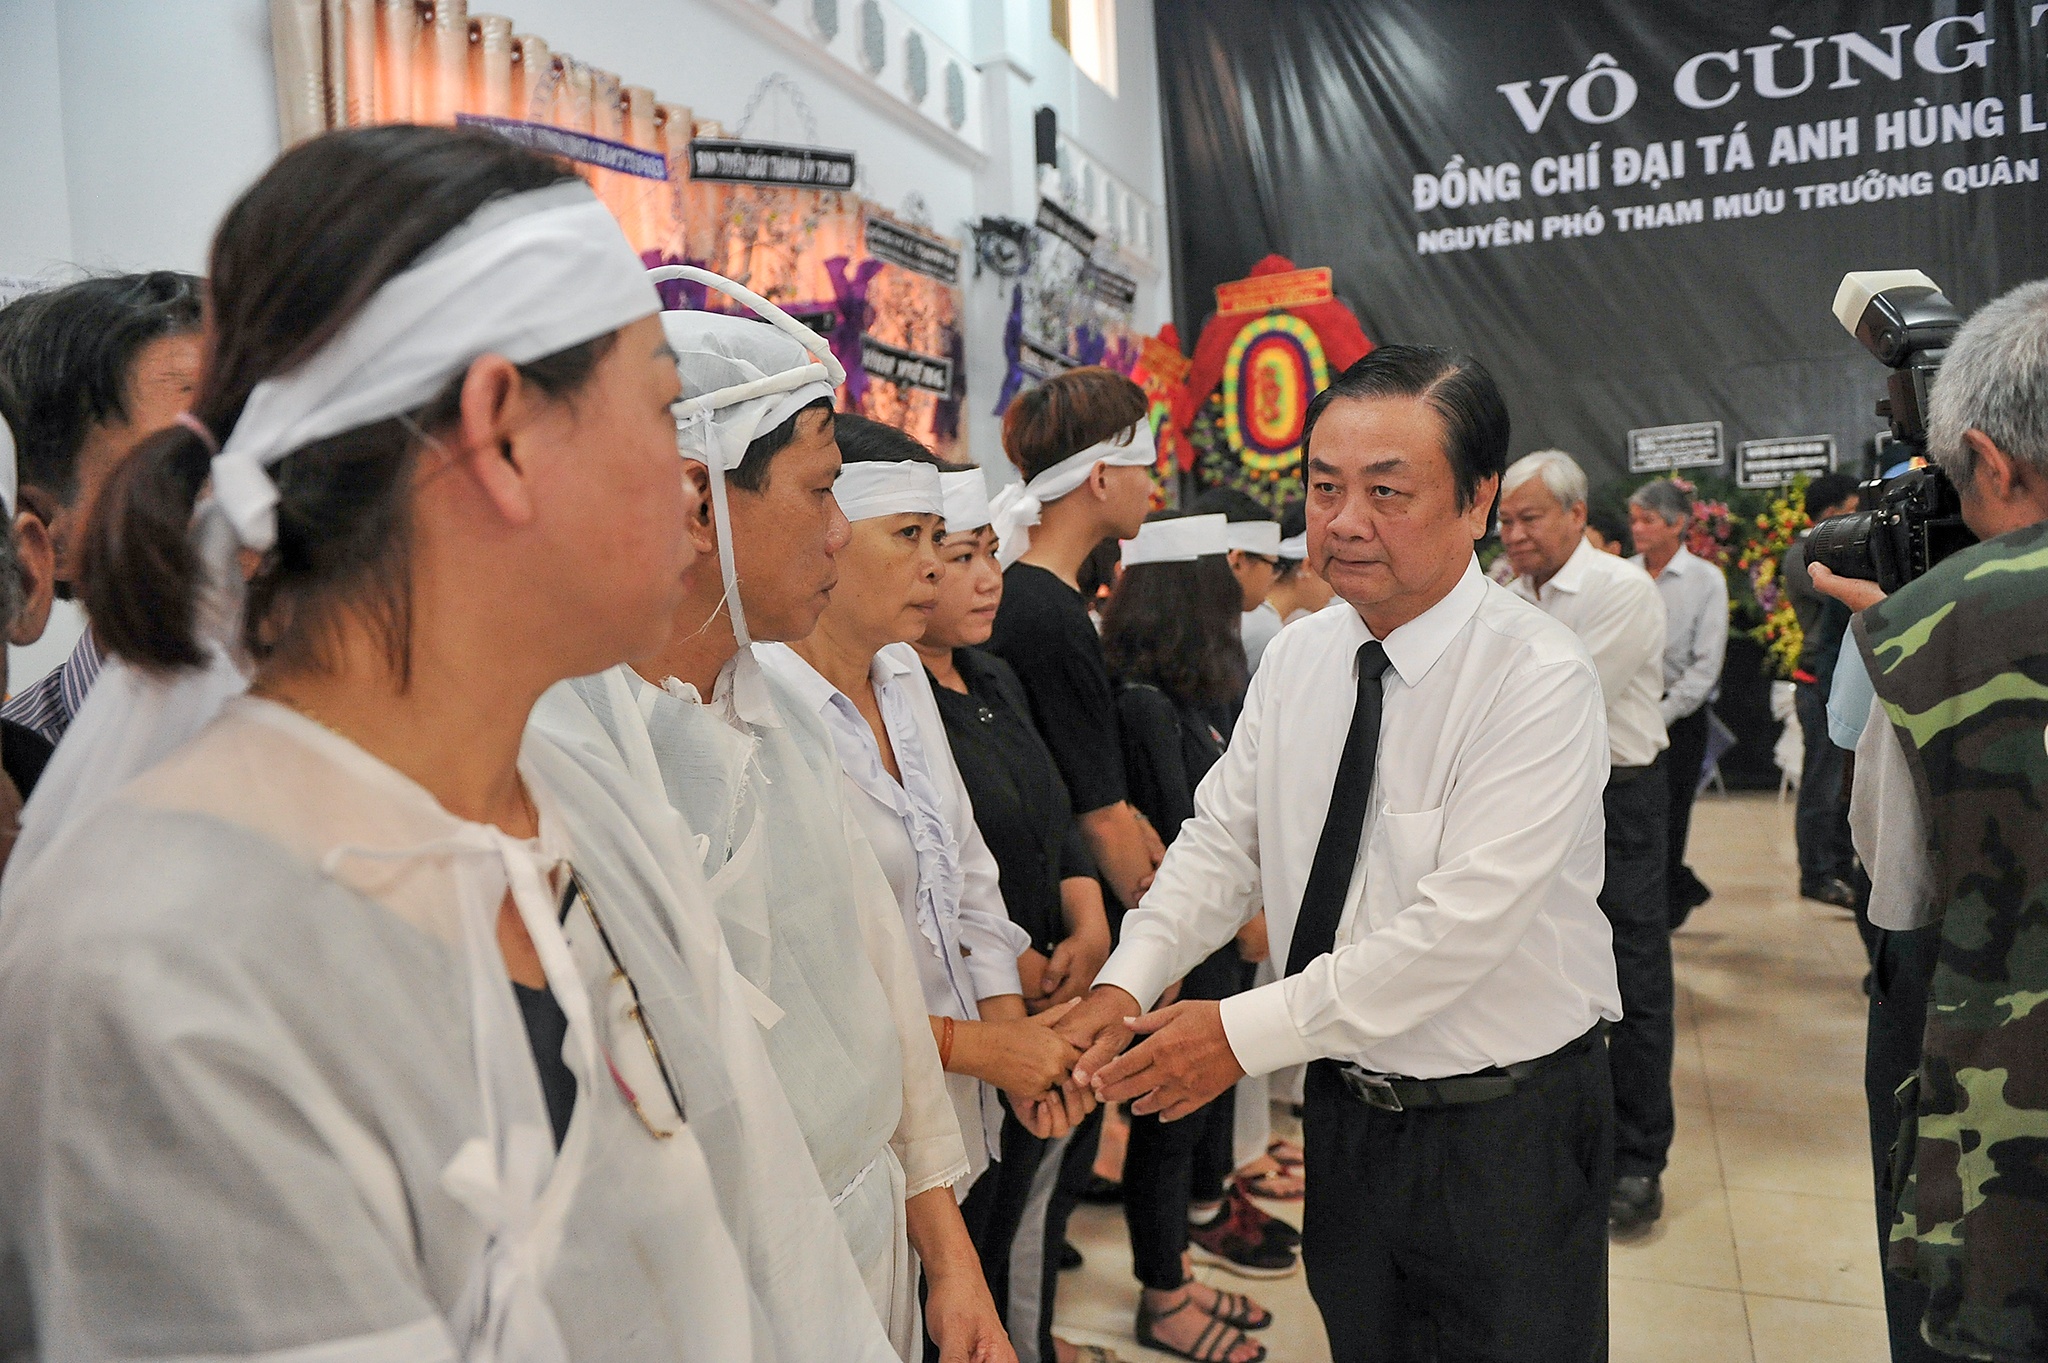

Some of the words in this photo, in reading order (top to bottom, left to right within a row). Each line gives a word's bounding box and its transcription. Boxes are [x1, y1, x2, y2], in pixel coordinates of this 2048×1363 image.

[1496, 52, 1638, 133] VÔ
[1673, 11, 1995, 109] CÙNG
[1412, 153, 1522, 212] ĐỒNG
[1530, 141, 1602, 196] CHÍ
[1612, 140, 1685, 190] ĐẠI
[1695, 121, 1755, 175] TÁ
[1768, 116, 1859, 167] ANH
[1875, 97, 2004, 152] HÙNG
[1417, 216, 1535, 255] NGUYÊN
[1541, 205, 1605, 241] PHÓ
[1612, 198, 1704, 232] THAM
[1712, 186, 1785, 220] MƯU
[1792, 168, 1934, 211] TRƯỞNG
[1941, 155, 2039, 194] QUÂN
